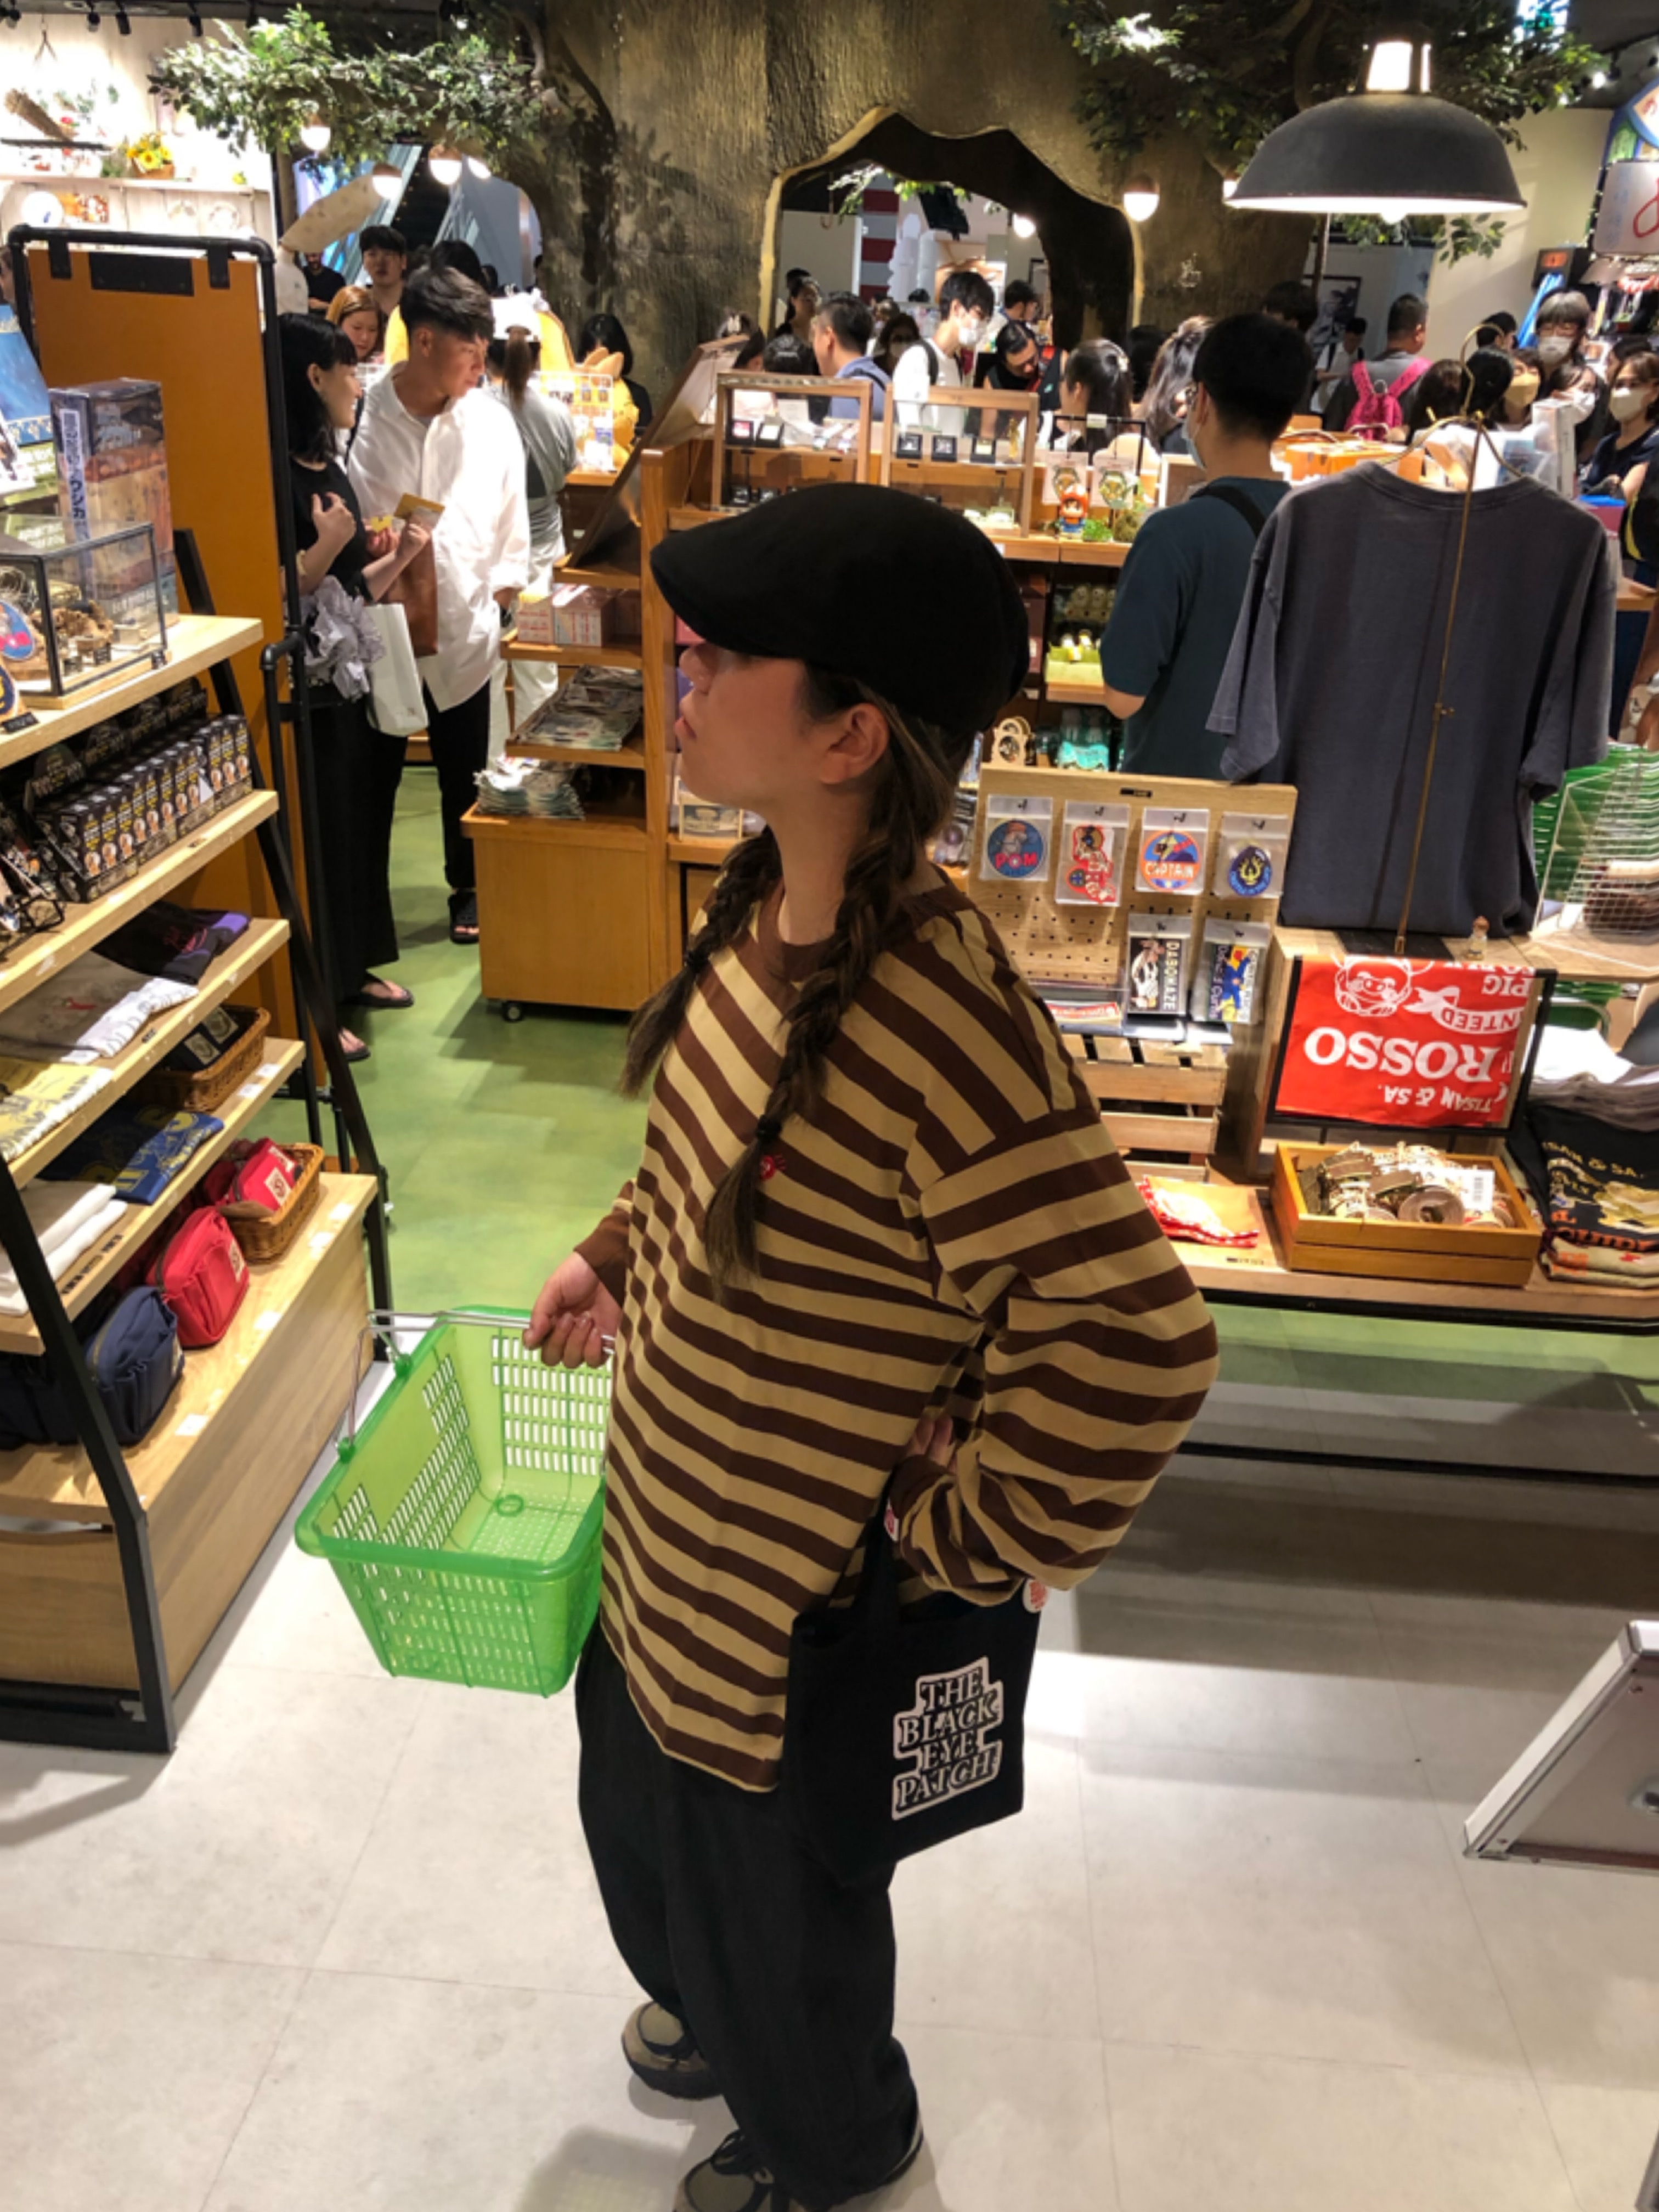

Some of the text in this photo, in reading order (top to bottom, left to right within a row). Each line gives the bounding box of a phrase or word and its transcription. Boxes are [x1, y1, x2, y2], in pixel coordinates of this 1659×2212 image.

[995, 851, 1037, 870] POM
[1145, 860, 1194, 878] CAPTAIN
[1481, 973, 1535, 997] PIG
[1304, 1026, 1502, 1082] ROSSO
[921, 1669, 981, 1712] THE
[901, 1690, 996, 1748] BLACK
[923, 1730, 974, 1770] EYE
[900, 1750, 992, 1808] PATCH
